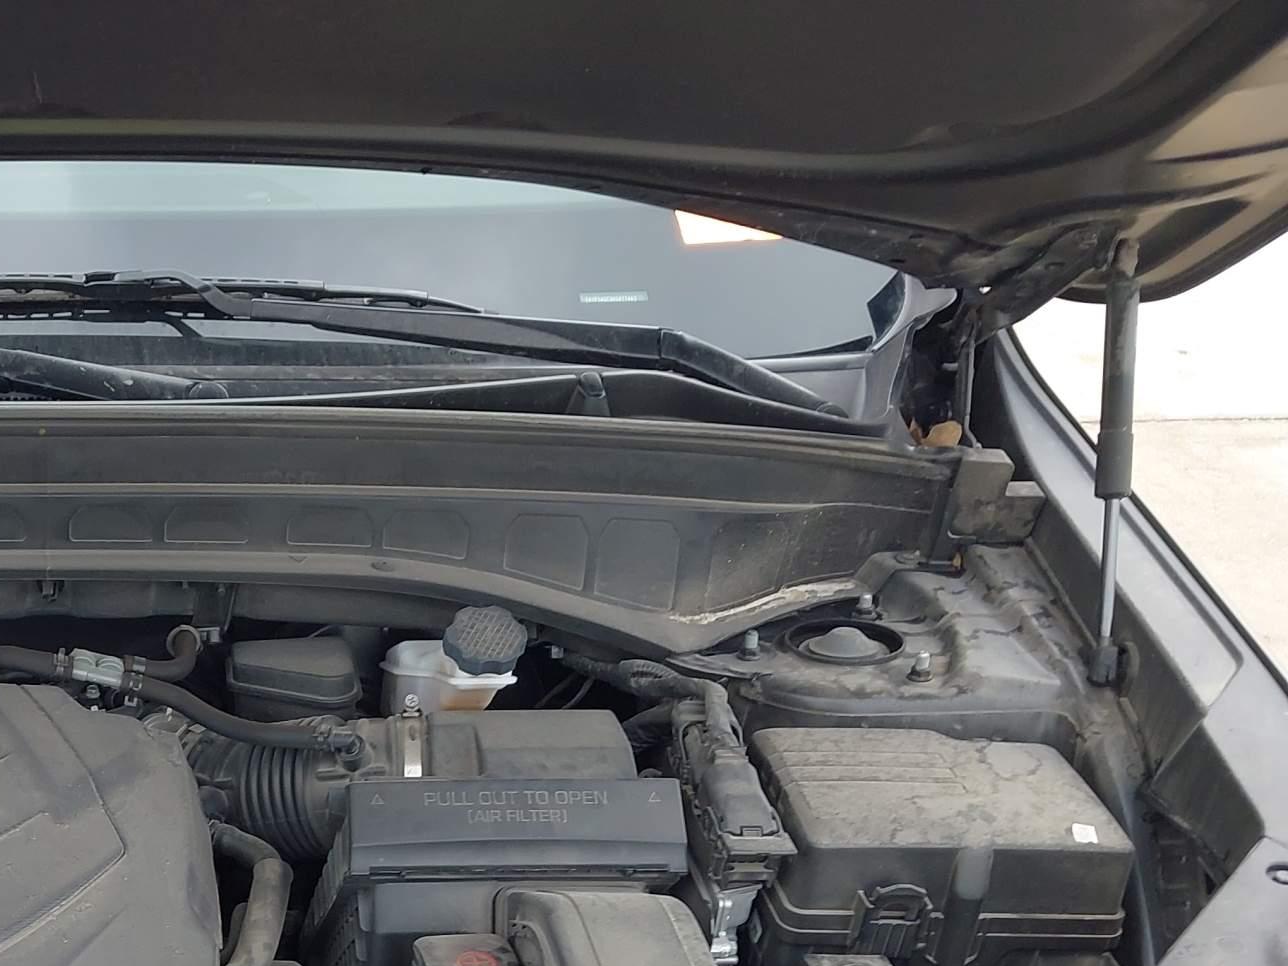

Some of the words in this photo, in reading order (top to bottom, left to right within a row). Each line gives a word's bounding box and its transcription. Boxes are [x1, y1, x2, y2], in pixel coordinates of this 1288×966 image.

[423, 791, 474, 806] PULL
[478, 790, 518, 806] OUT
[523, 790, 548, 806] TO
[555, 789, 609, 806] OPEN
